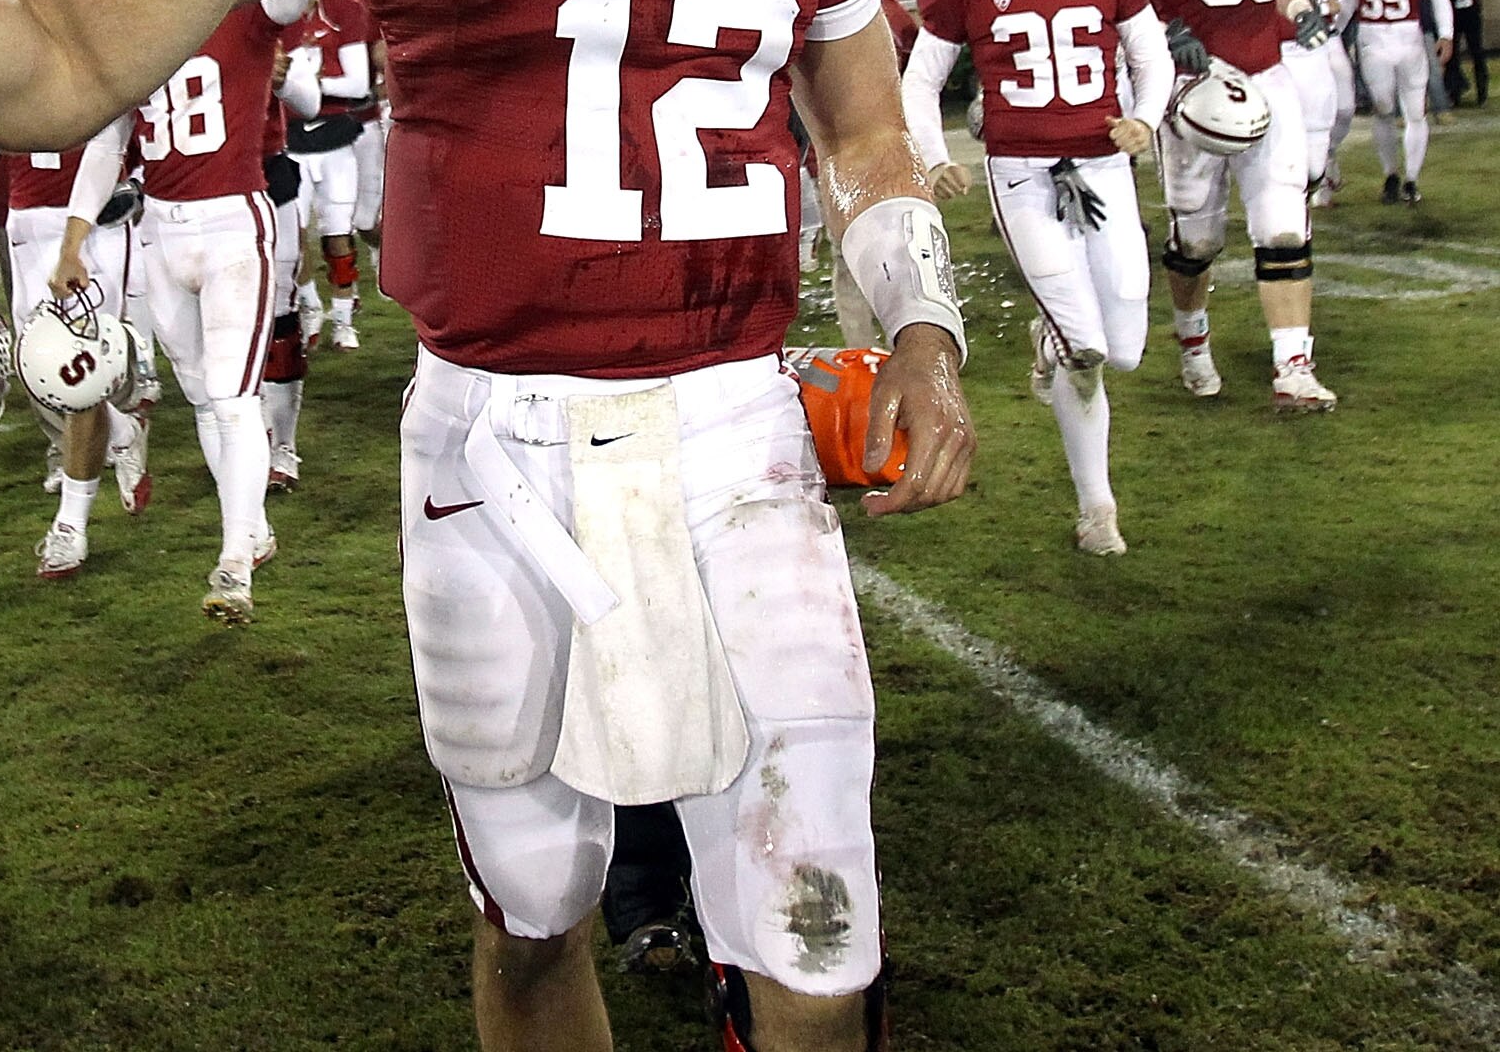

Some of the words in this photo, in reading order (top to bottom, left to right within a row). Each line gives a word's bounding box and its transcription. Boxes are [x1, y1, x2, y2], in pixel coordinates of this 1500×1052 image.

[138, 54, 228, 161] 38
[990, 5, 1106, 110] 36
[59, 350, 97, 387] S
